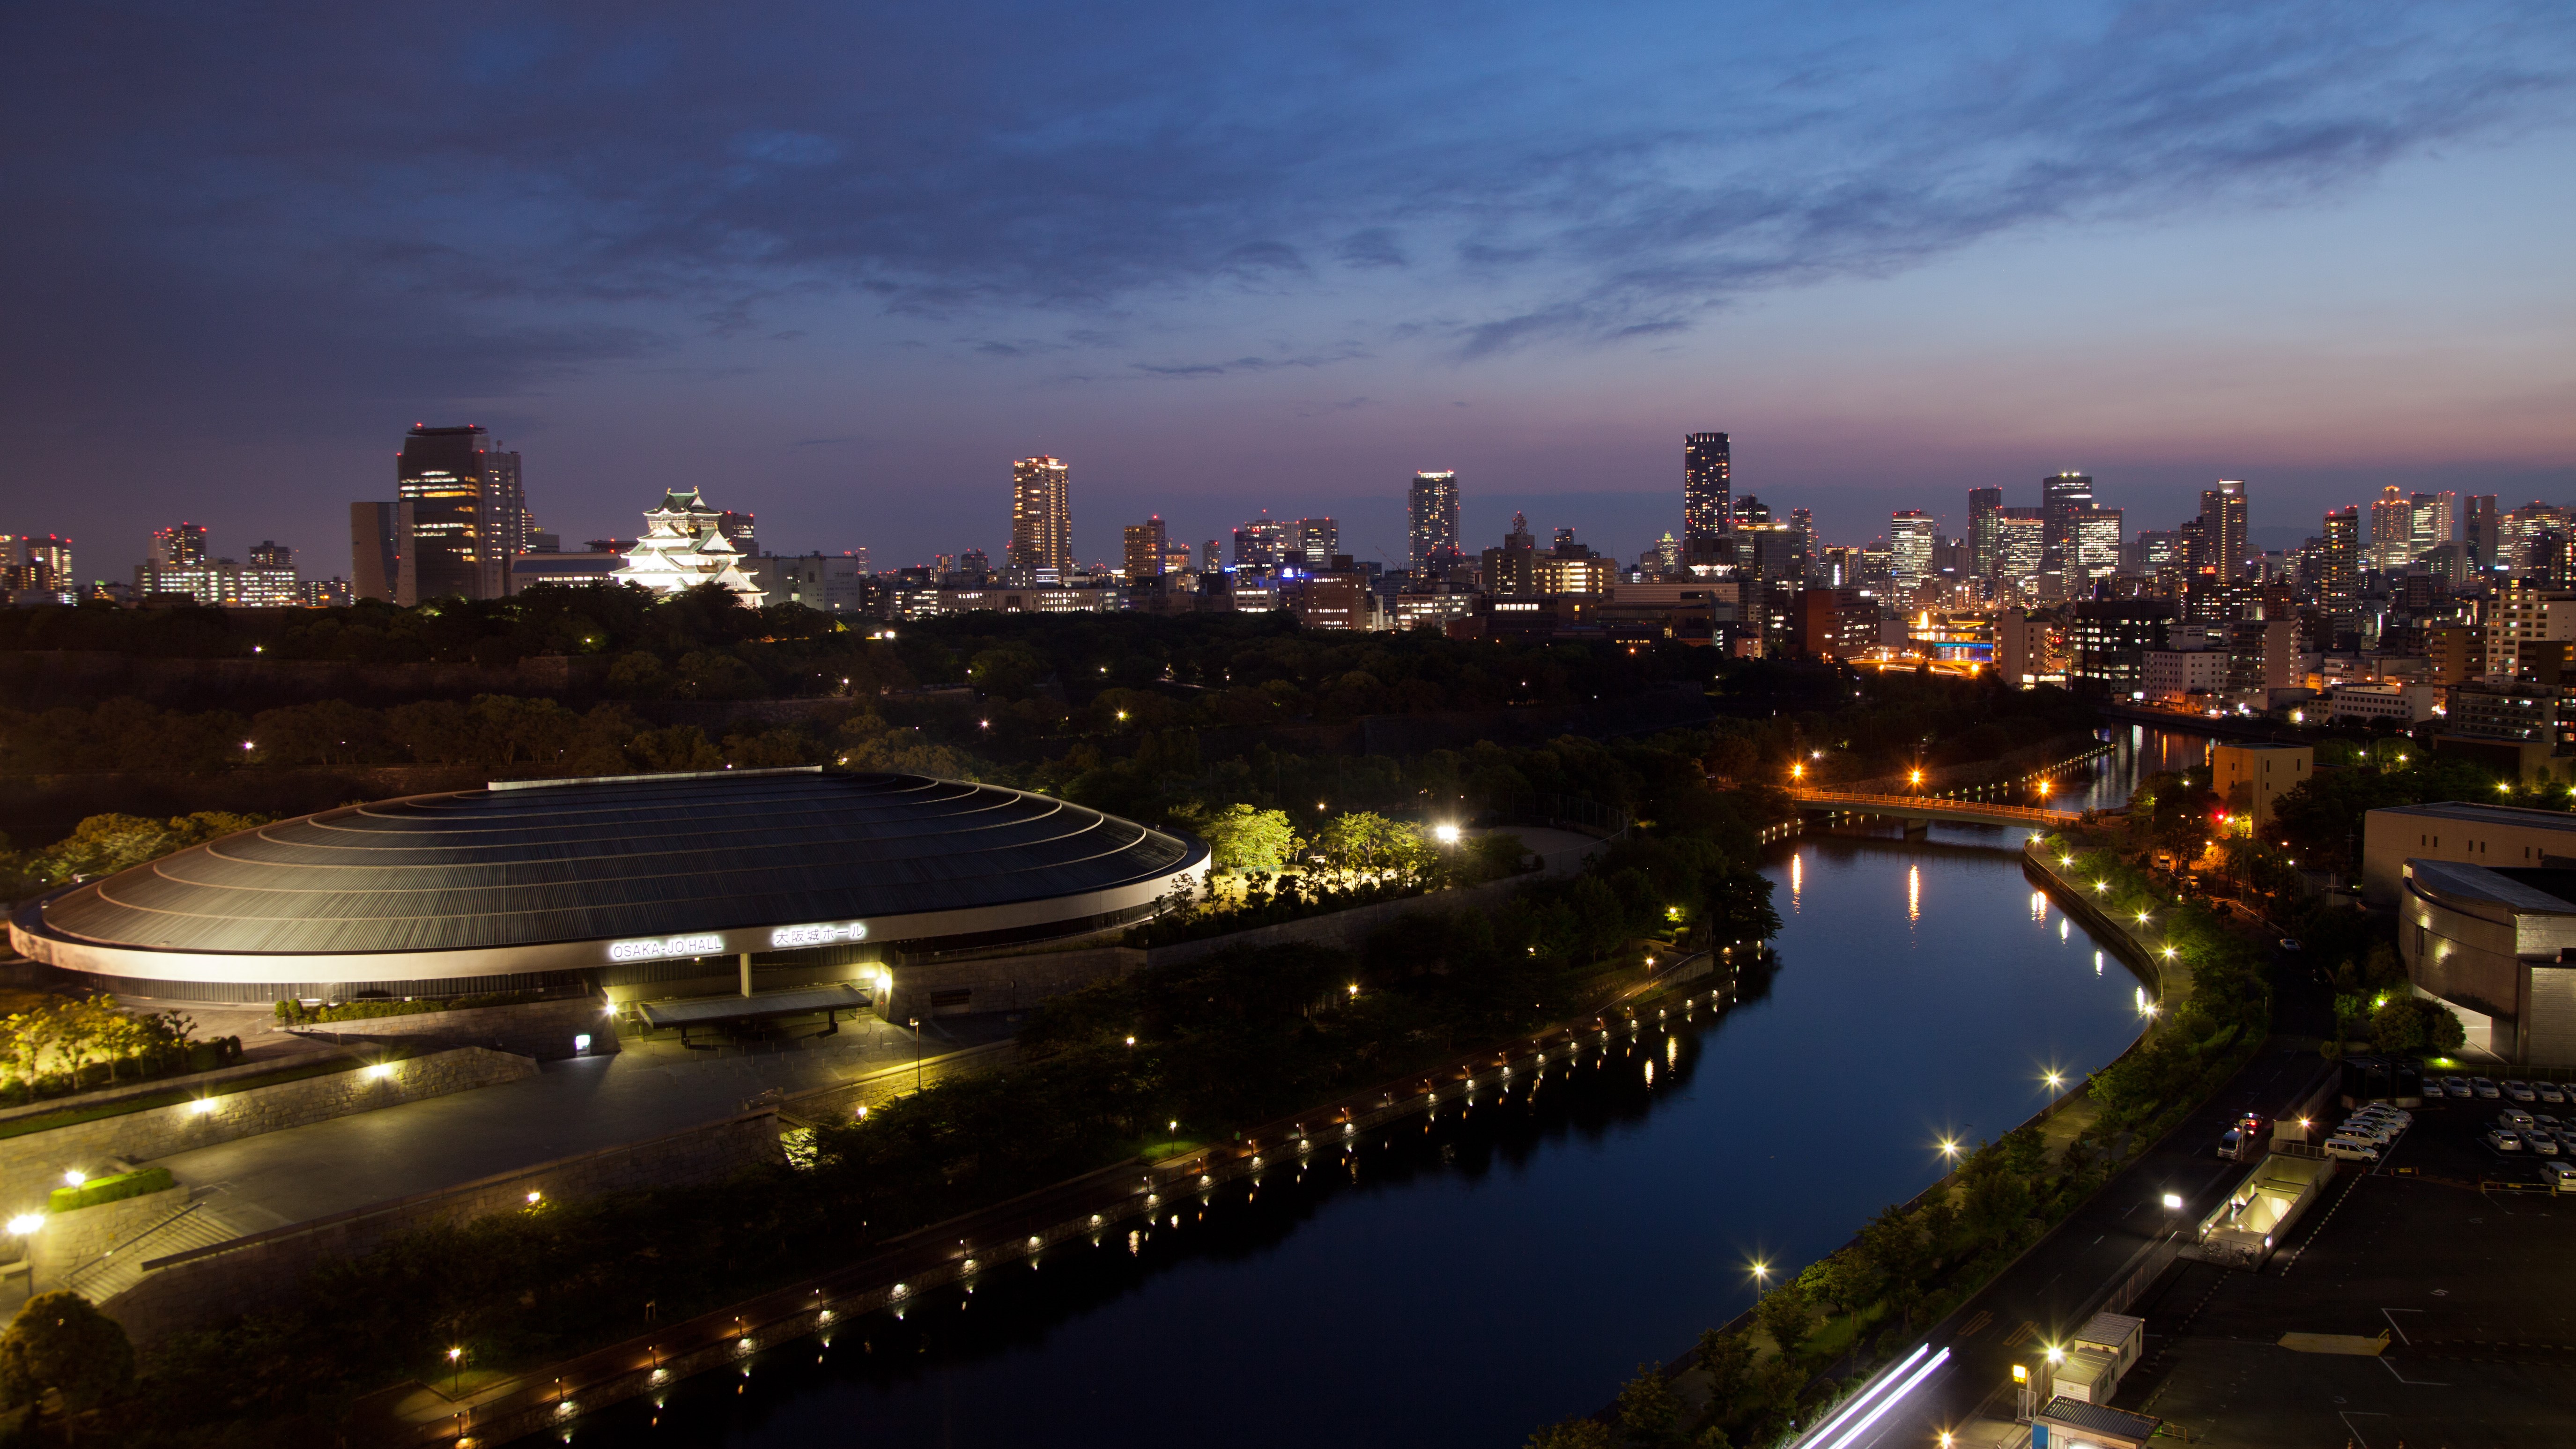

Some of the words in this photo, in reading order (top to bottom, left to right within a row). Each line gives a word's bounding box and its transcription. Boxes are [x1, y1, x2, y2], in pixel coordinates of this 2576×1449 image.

[776, 925, 864, 944] 大阪城ホール
[614, 940, 684, 958] OSAKA-JO
[689, 938, 722, 952] HALL
